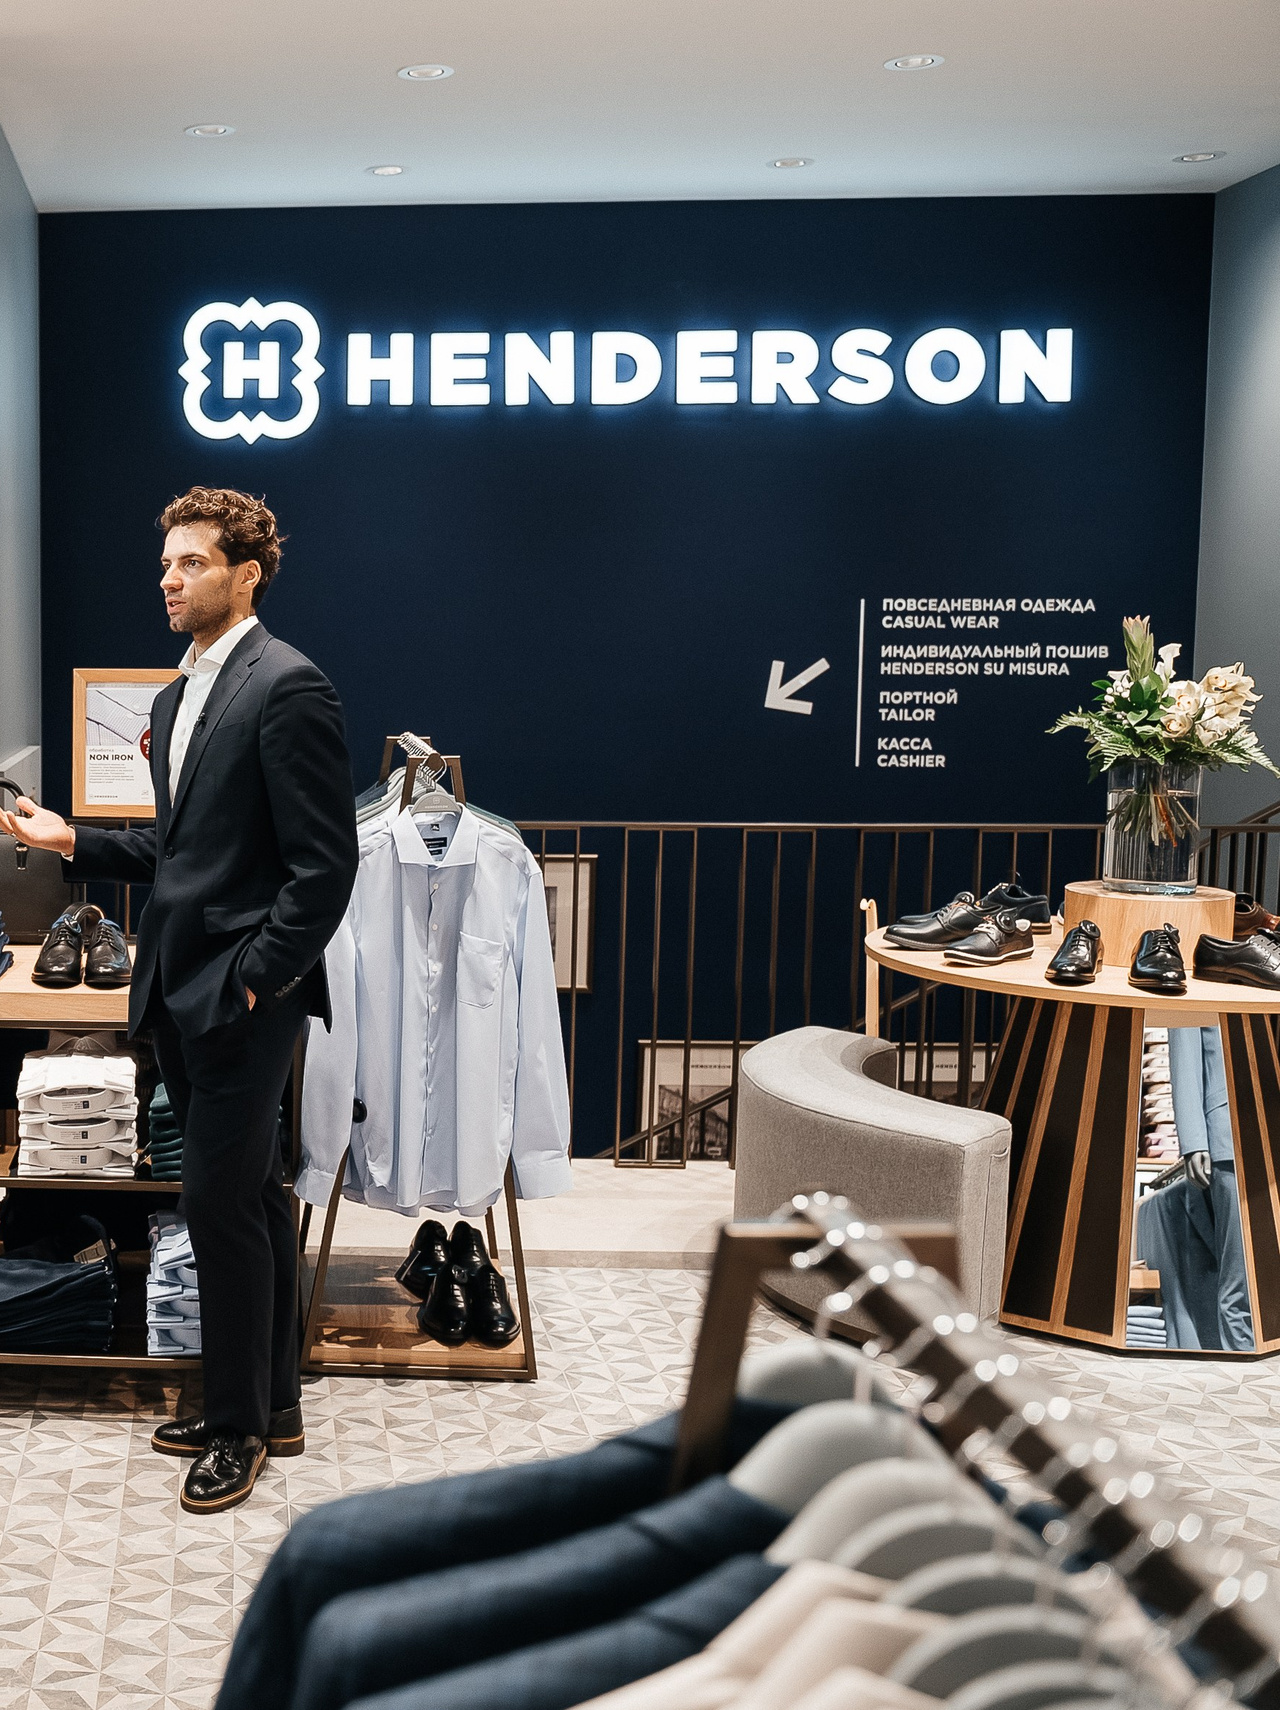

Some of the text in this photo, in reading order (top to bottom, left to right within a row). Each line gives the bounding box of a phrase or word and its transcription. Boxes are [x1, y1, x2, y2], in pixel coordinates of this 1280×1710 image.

[223, 328, 1073, 406] H HENDERSON
[882, 598, 1096, 613] ПОВСЕДНЕВНАЯ ОДЕЖДА
[882, 615, 1000, 629] CASUAL WEAR
[881, 643, 1109, 659] ИНДИВИДУАЛЬНЫЙ ПОШИВ
[880, 662, 1070, 675] HENDERSON SU MISURA
[879, 689, 958, 704] ПОРТНОЙ
[879, 708, 936, 722] TAILOR
[877, 737, 933, 751] КАССА
[877, 754, 946, 768] CASHIER
